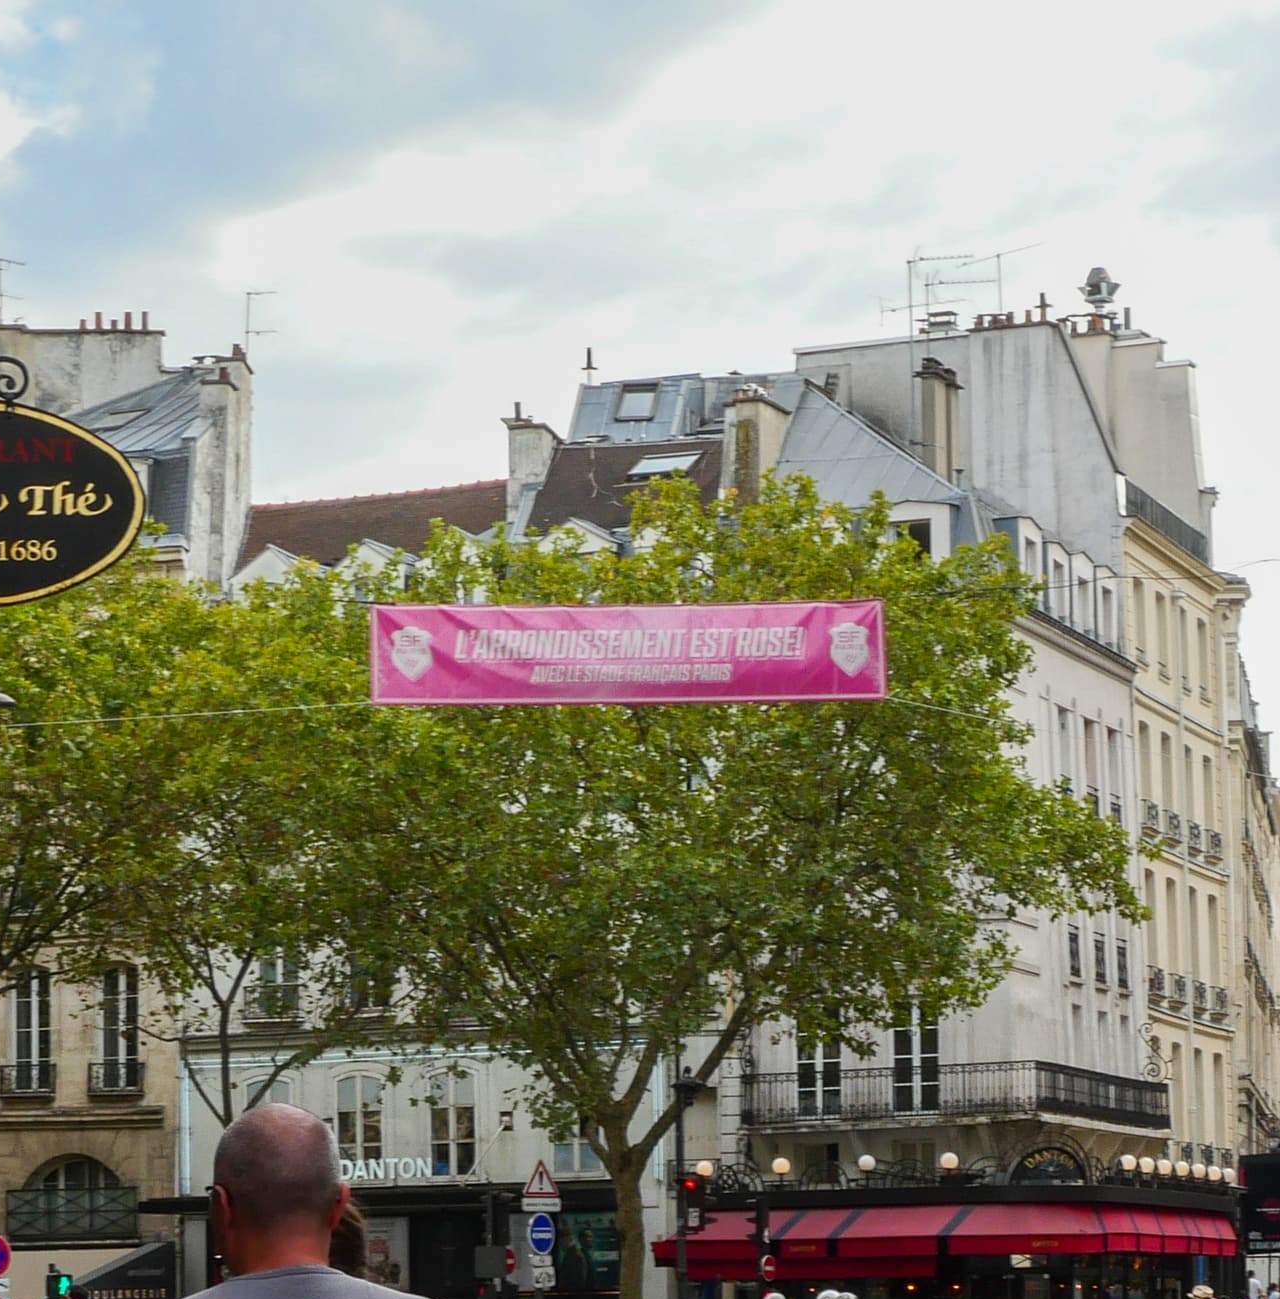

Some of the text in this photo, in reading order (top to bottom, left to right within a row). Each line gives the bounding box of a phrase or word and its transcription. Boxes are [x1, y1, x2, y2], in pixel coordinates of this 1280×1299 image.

[19, 481, 113, 517] Thé
[455, 625, 805, 662] L'ARRONDISSEMENT EST ROSE!
[531, 664, 566, 683] AVEC
[584, 664, 624, 682] STADE
[691, 663, 732, 682] PARIS
[338, 1157, 433, 1180] DANTON
